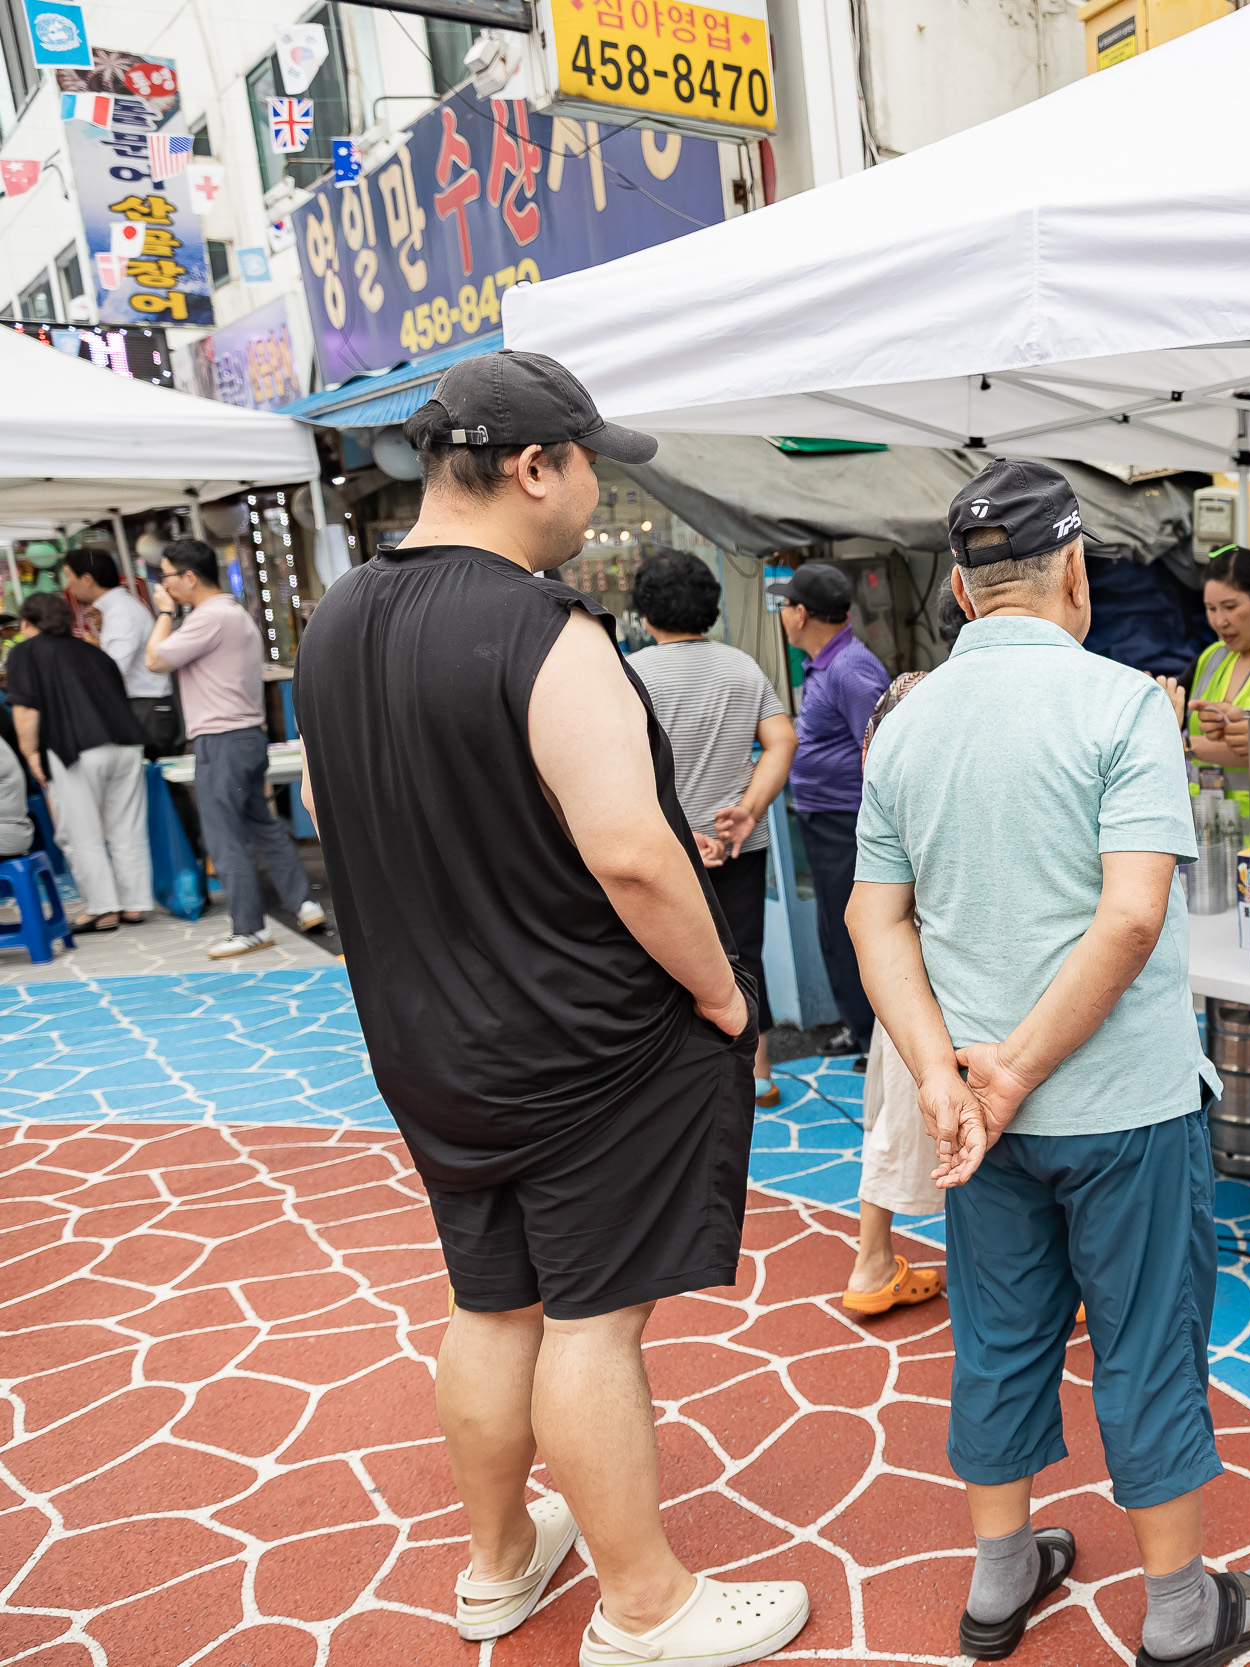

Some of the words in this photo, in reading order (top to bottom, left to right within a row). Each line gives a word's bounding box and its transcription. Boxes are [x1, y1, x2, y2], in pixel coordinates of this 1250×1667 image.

[593, 0, 732, 51] 심야영업
[572, 35, 768, 117] 458-8470
[306, 143, 426, 330] 영일만
[433, 98, 541, 276] 수산
